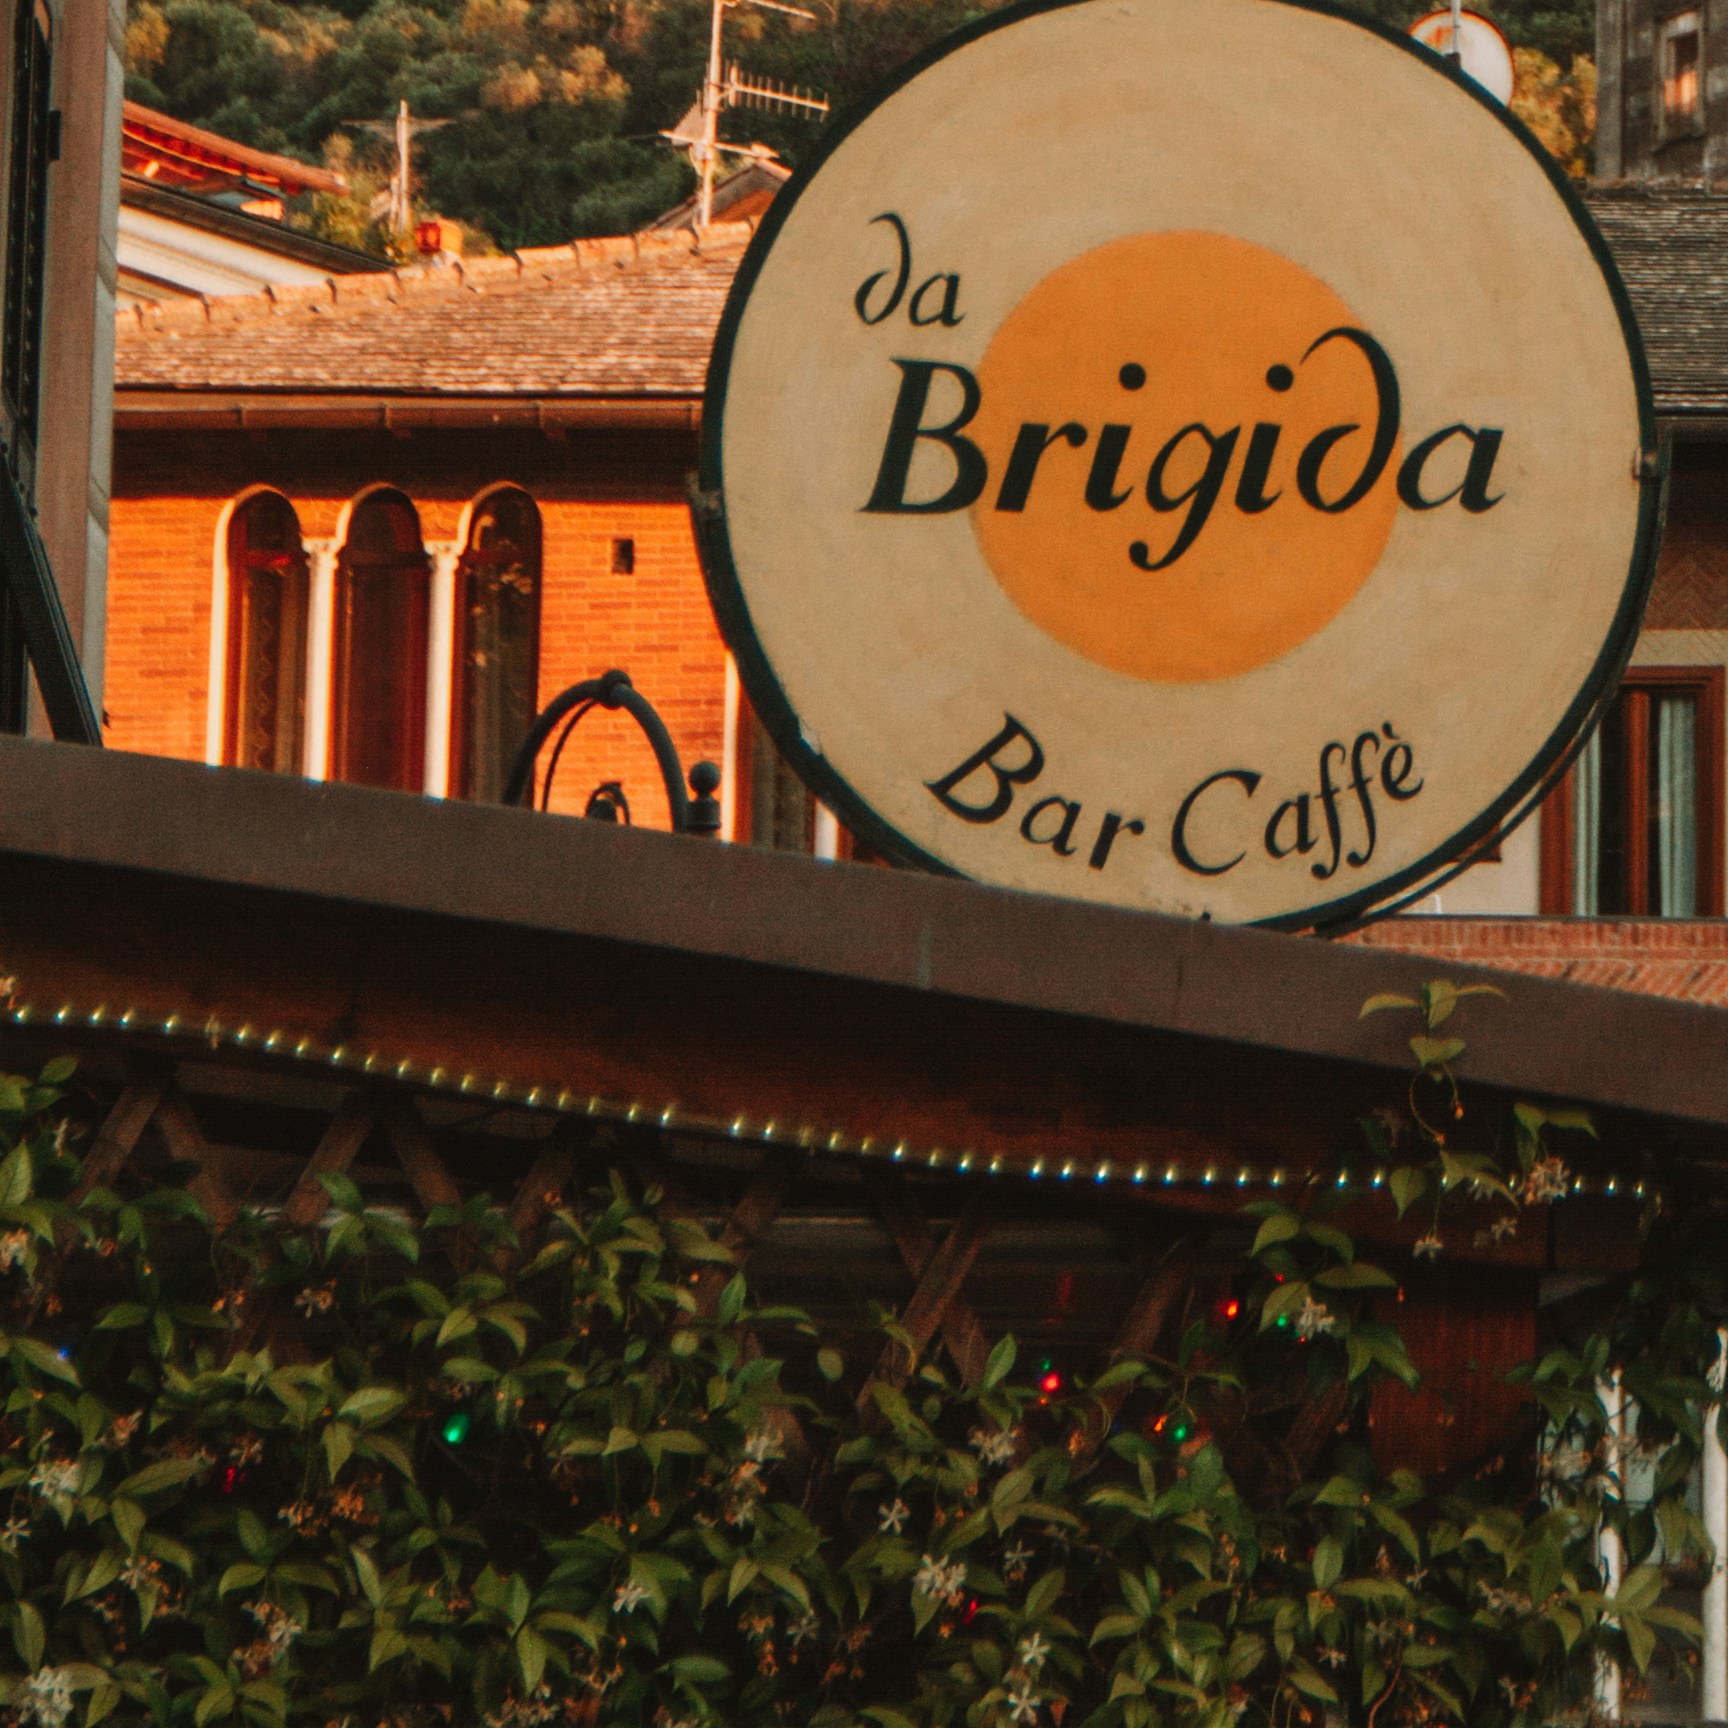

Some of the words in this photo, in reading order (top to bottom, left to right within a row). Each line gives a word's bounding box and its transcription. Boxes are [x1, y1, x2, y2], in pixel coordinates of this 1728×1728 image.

[855, 212, 965, 328] da
[858, 326, 1506, 572] Brigida
[922, 712, 1146, 871] Bar
[1170, 720, 1425, 880] Caffè
